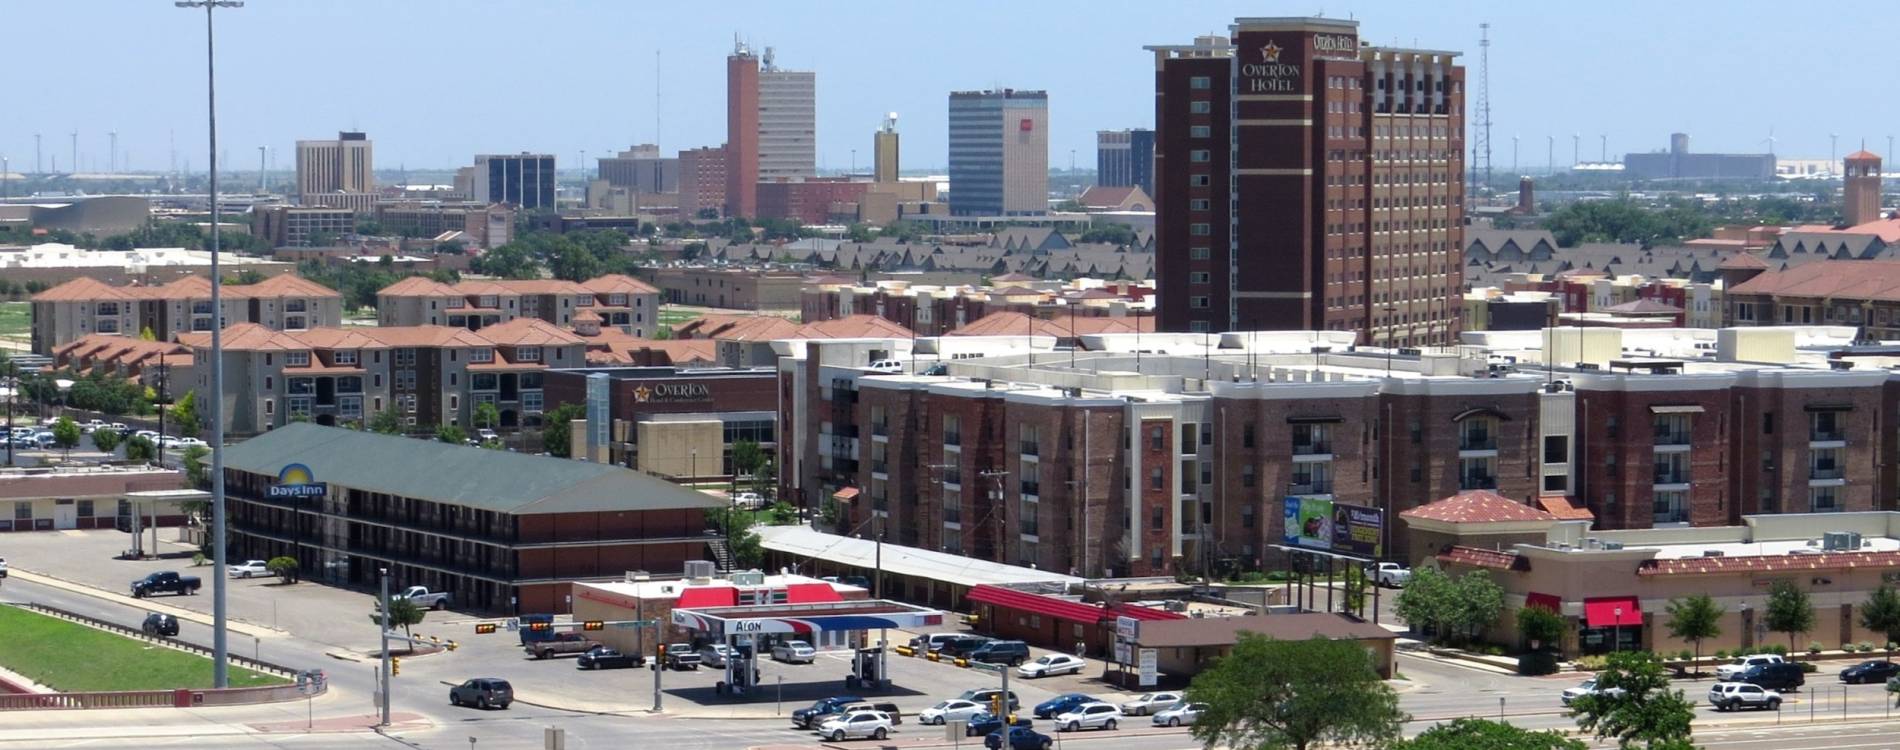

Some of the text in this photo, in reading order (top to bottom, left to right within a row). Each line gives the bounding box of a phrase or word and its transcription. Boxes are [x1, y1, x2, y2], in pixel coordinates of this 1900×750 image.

[1242, 64, 1300, 78] OVERTON
[1251, 79, 1294, 91] HOTEL
[655, 383, 709, 397] OVERTON
[271, 486, 323, 496] Days Inn
[736, 621, 762, 632] ALON
